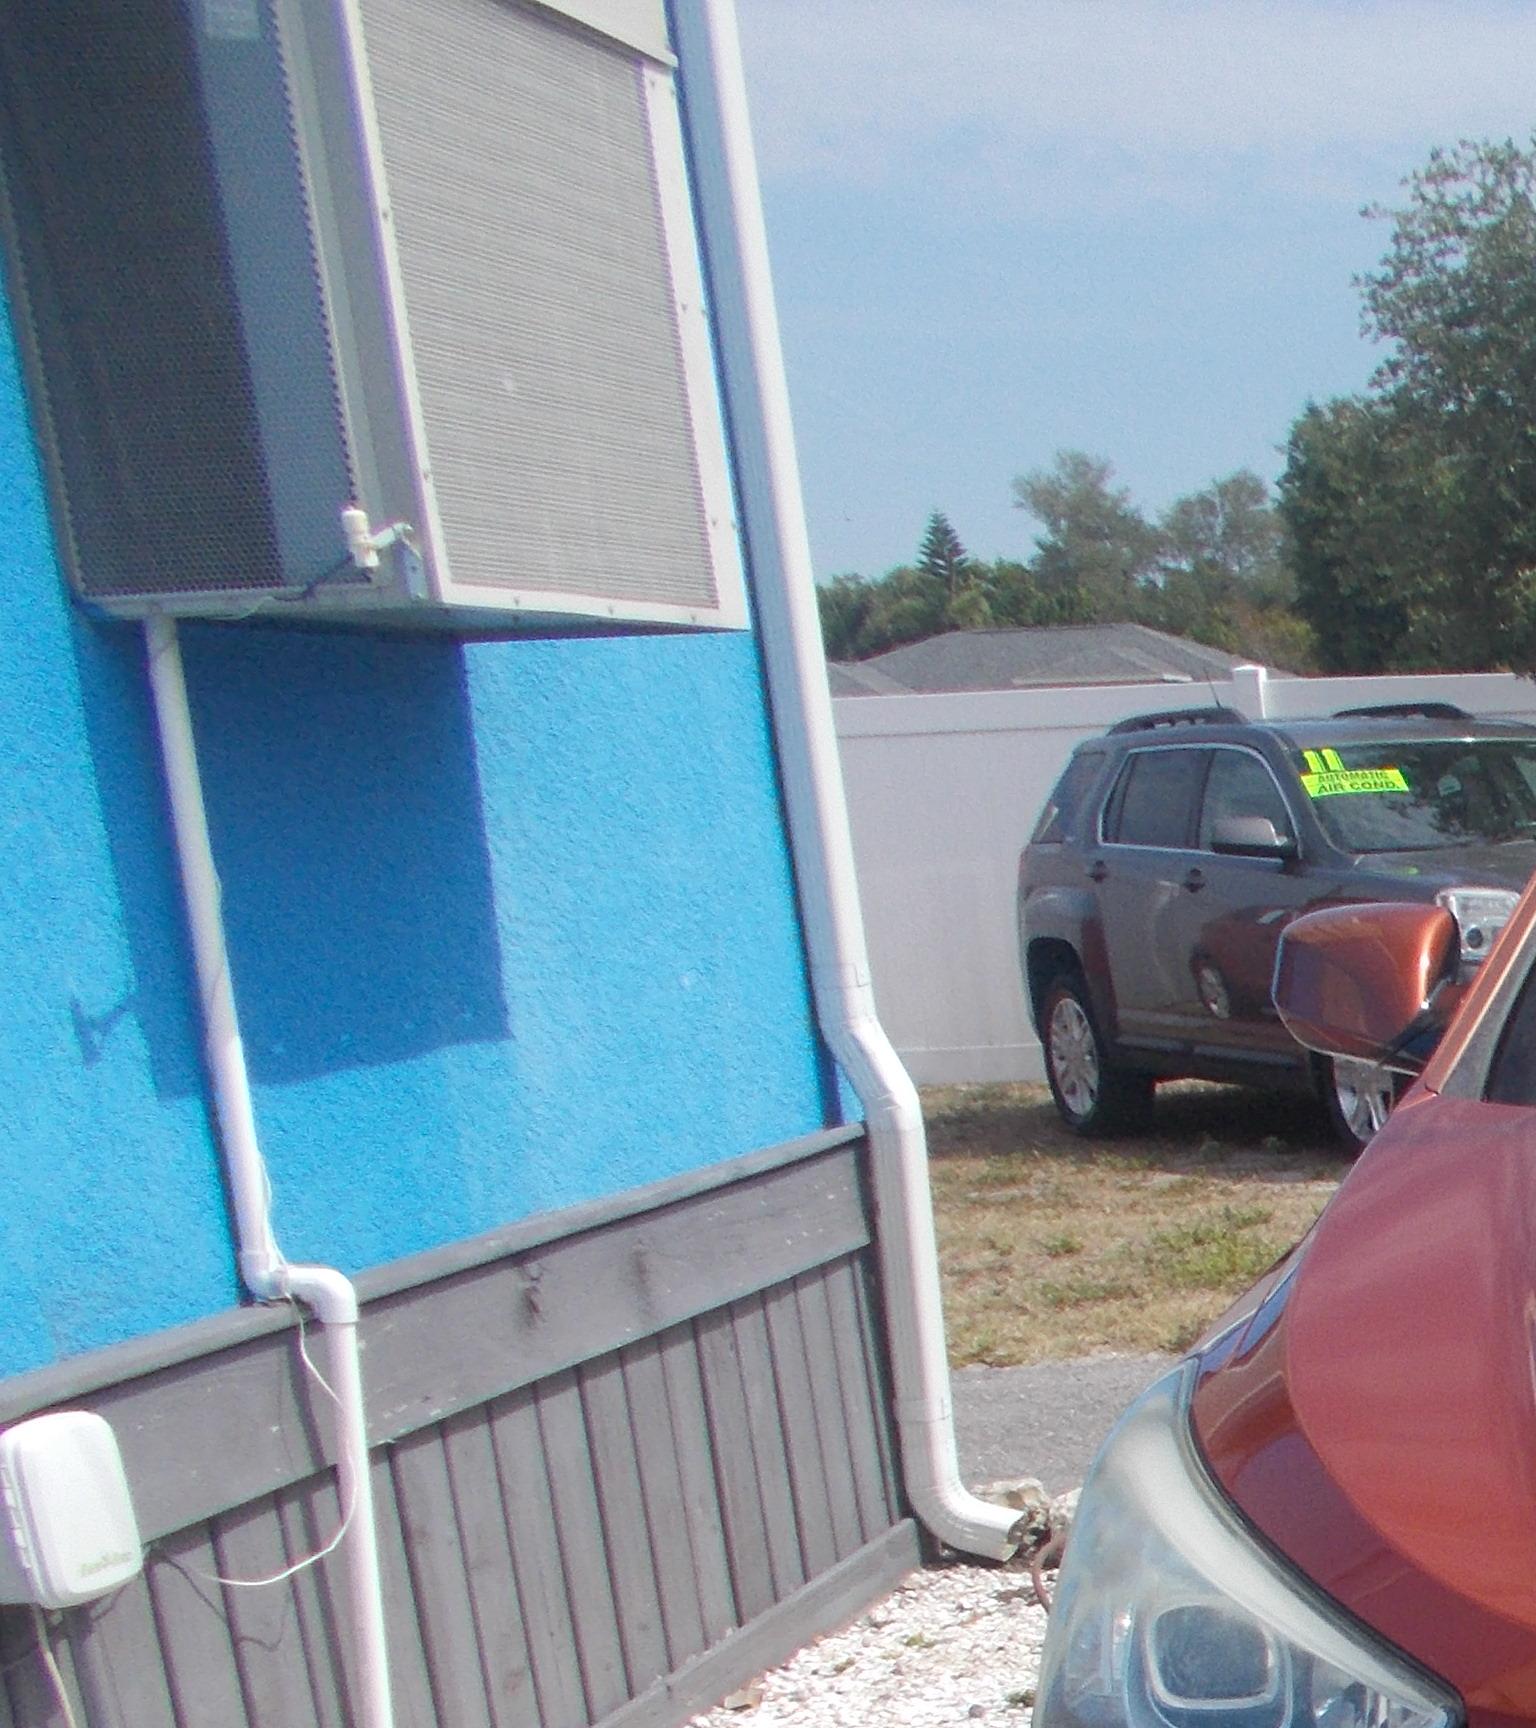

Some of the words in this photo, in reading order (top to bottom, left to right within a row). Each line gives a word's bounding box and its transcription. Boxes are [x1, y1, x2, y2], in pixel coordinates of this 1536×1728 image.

[1303, 748, 1346, 774] 11
[1317, 769, 1391, 784] AUTOMATIC
[1317, 783, 1344, 795] AIR
